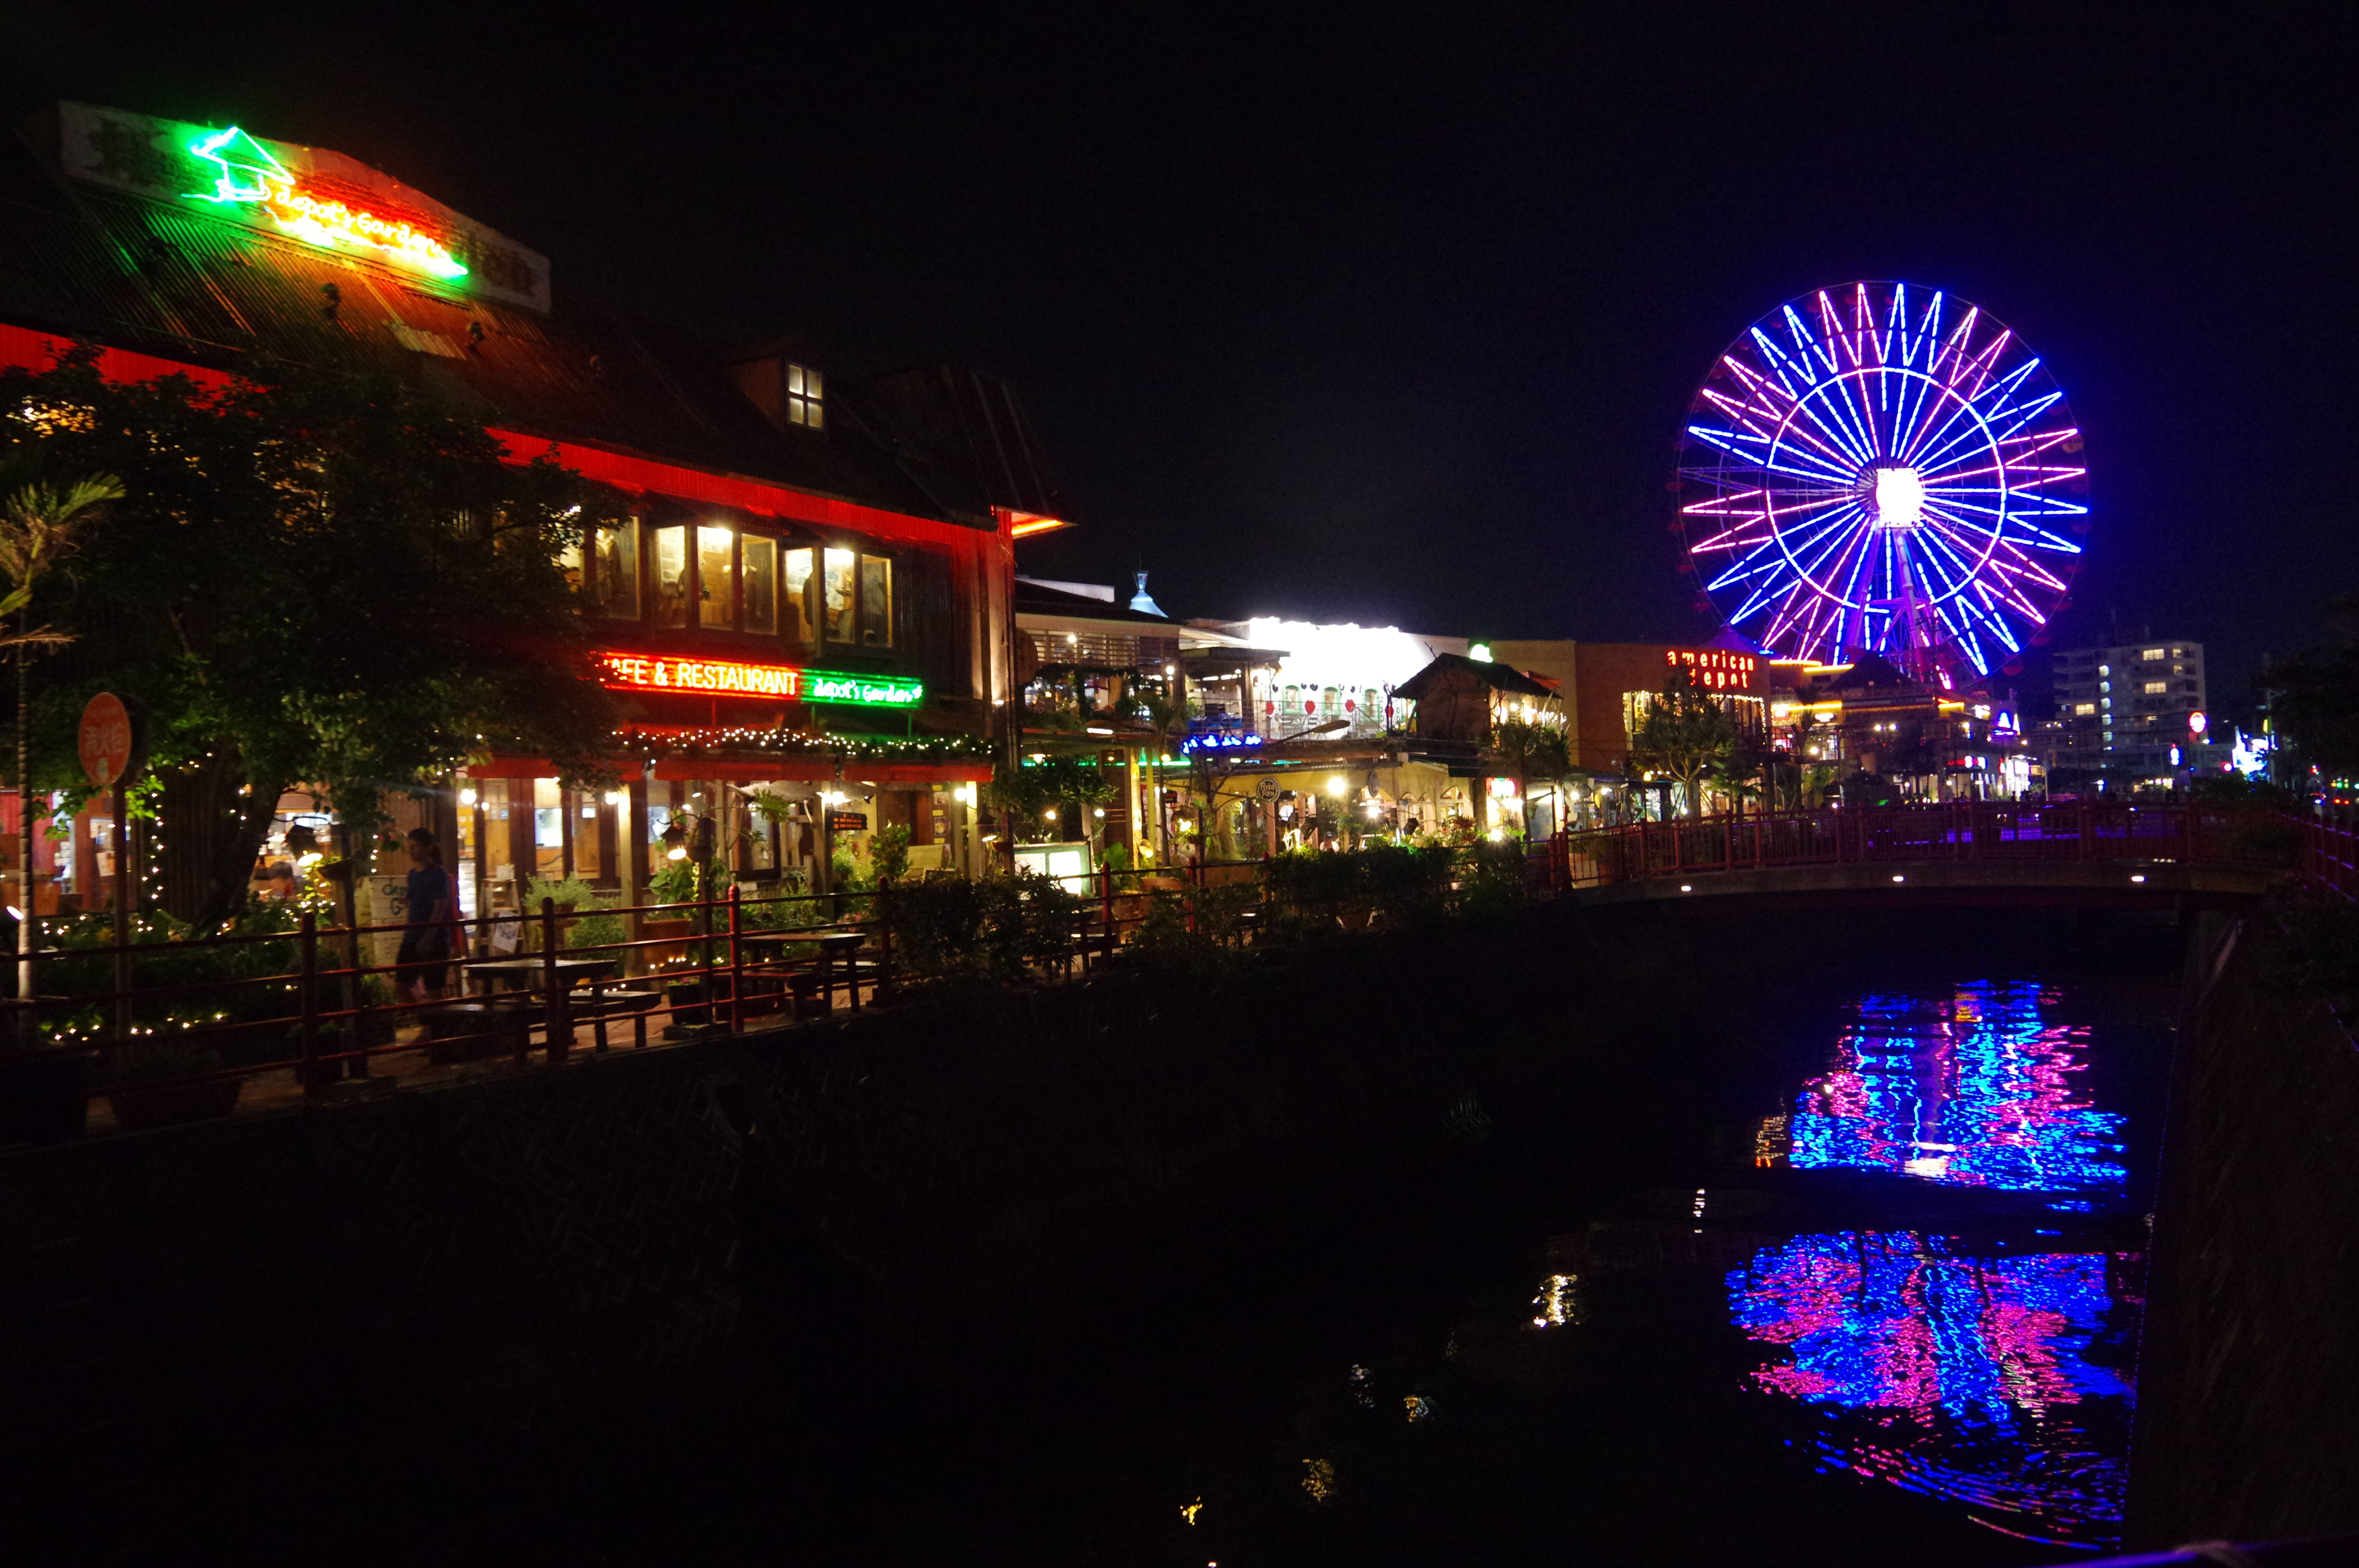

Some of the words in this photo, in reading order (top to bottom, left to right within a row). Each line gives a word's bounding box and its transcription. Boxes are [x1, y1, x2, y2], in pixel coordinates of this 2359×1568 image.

[1667, 650, 1754, 671] american
[655, 662, 668, 686] &
[676, 663, 798, 695] RESTAURANT
